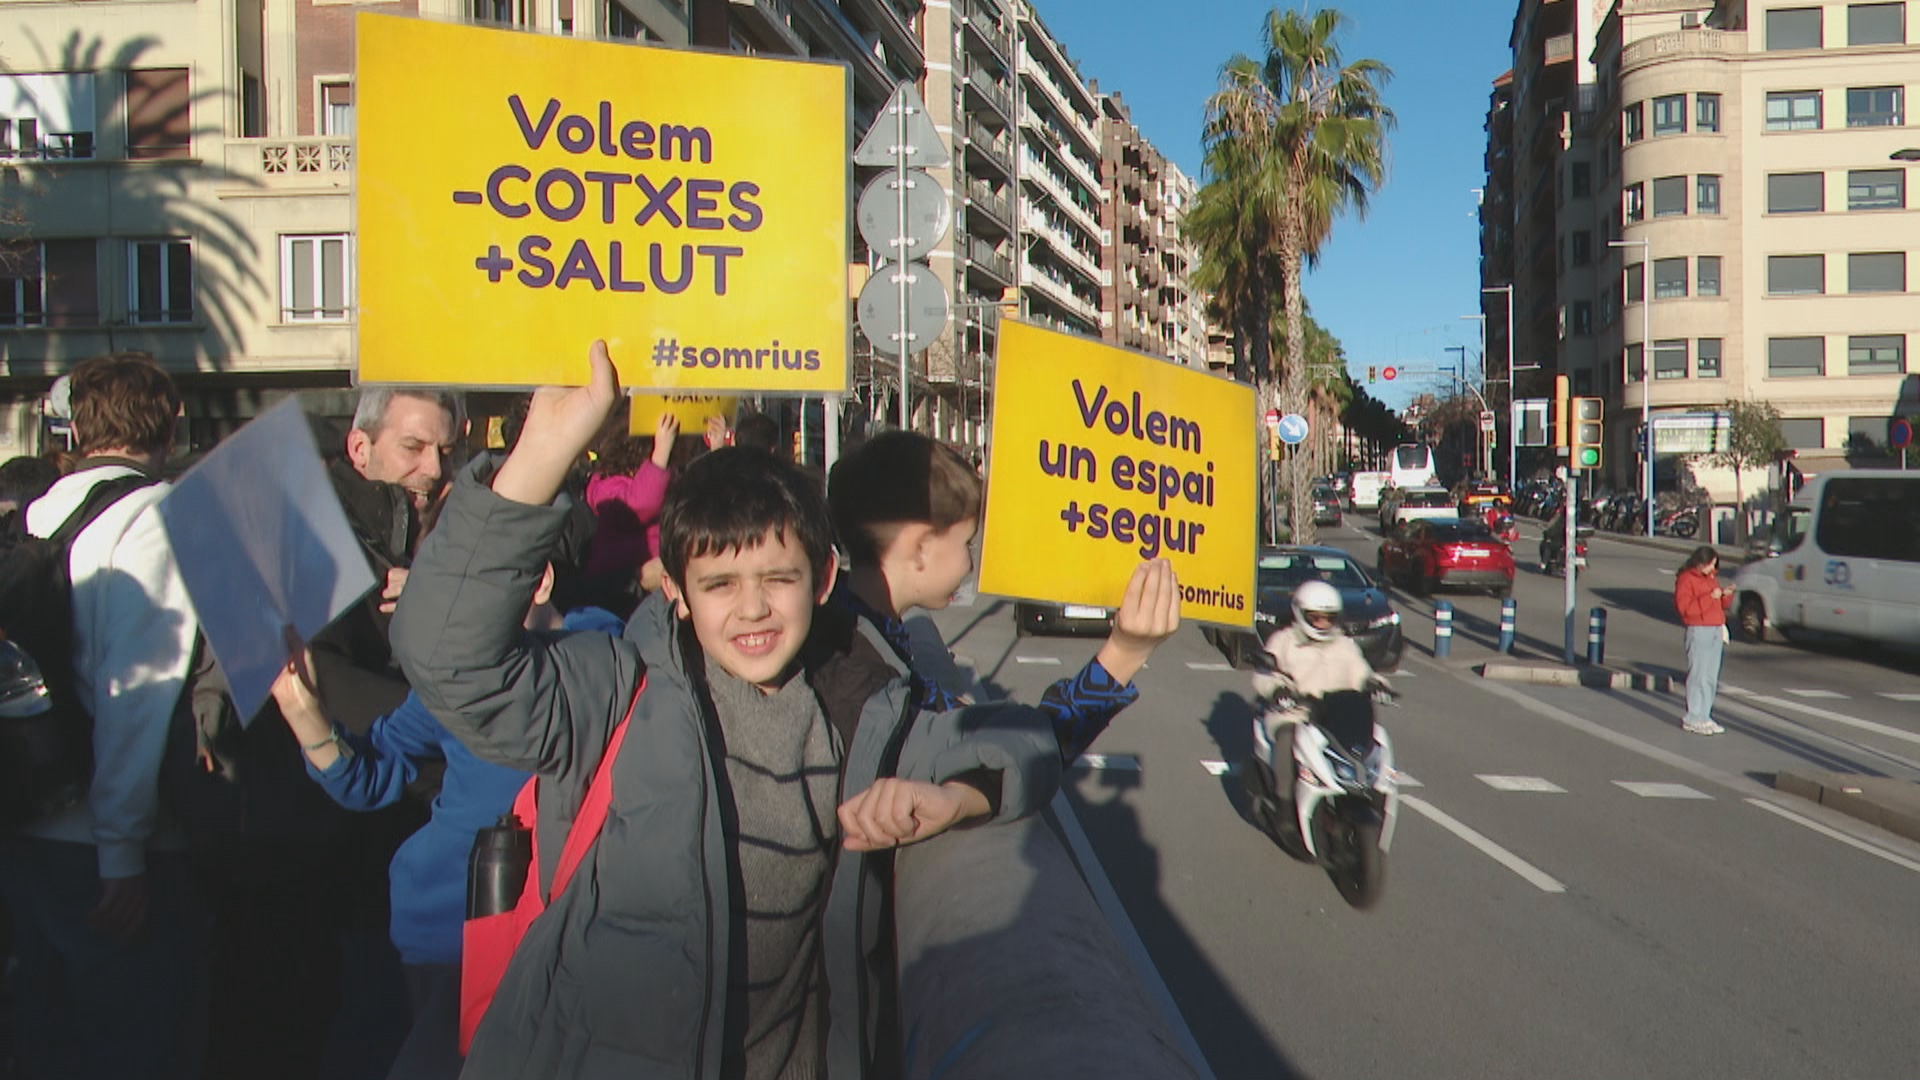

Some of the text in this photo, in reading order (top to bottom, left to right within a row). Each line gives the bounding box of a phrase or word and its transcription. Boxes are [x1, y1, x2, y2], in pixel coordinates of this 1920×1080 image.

[507, 94, 712, 164] Volem
[452, 164, 763, 232] -COTXES
[475, 235, 743, 295] +SALUT
[653, 339, 820, 370] #somrius
[1071, 379, 1201, 454] Volem
[1038, 439, 1214, 511] un espai
[1060, 501, 1205, 561] +segur
[1178, 584, 1244, 611] somrius
